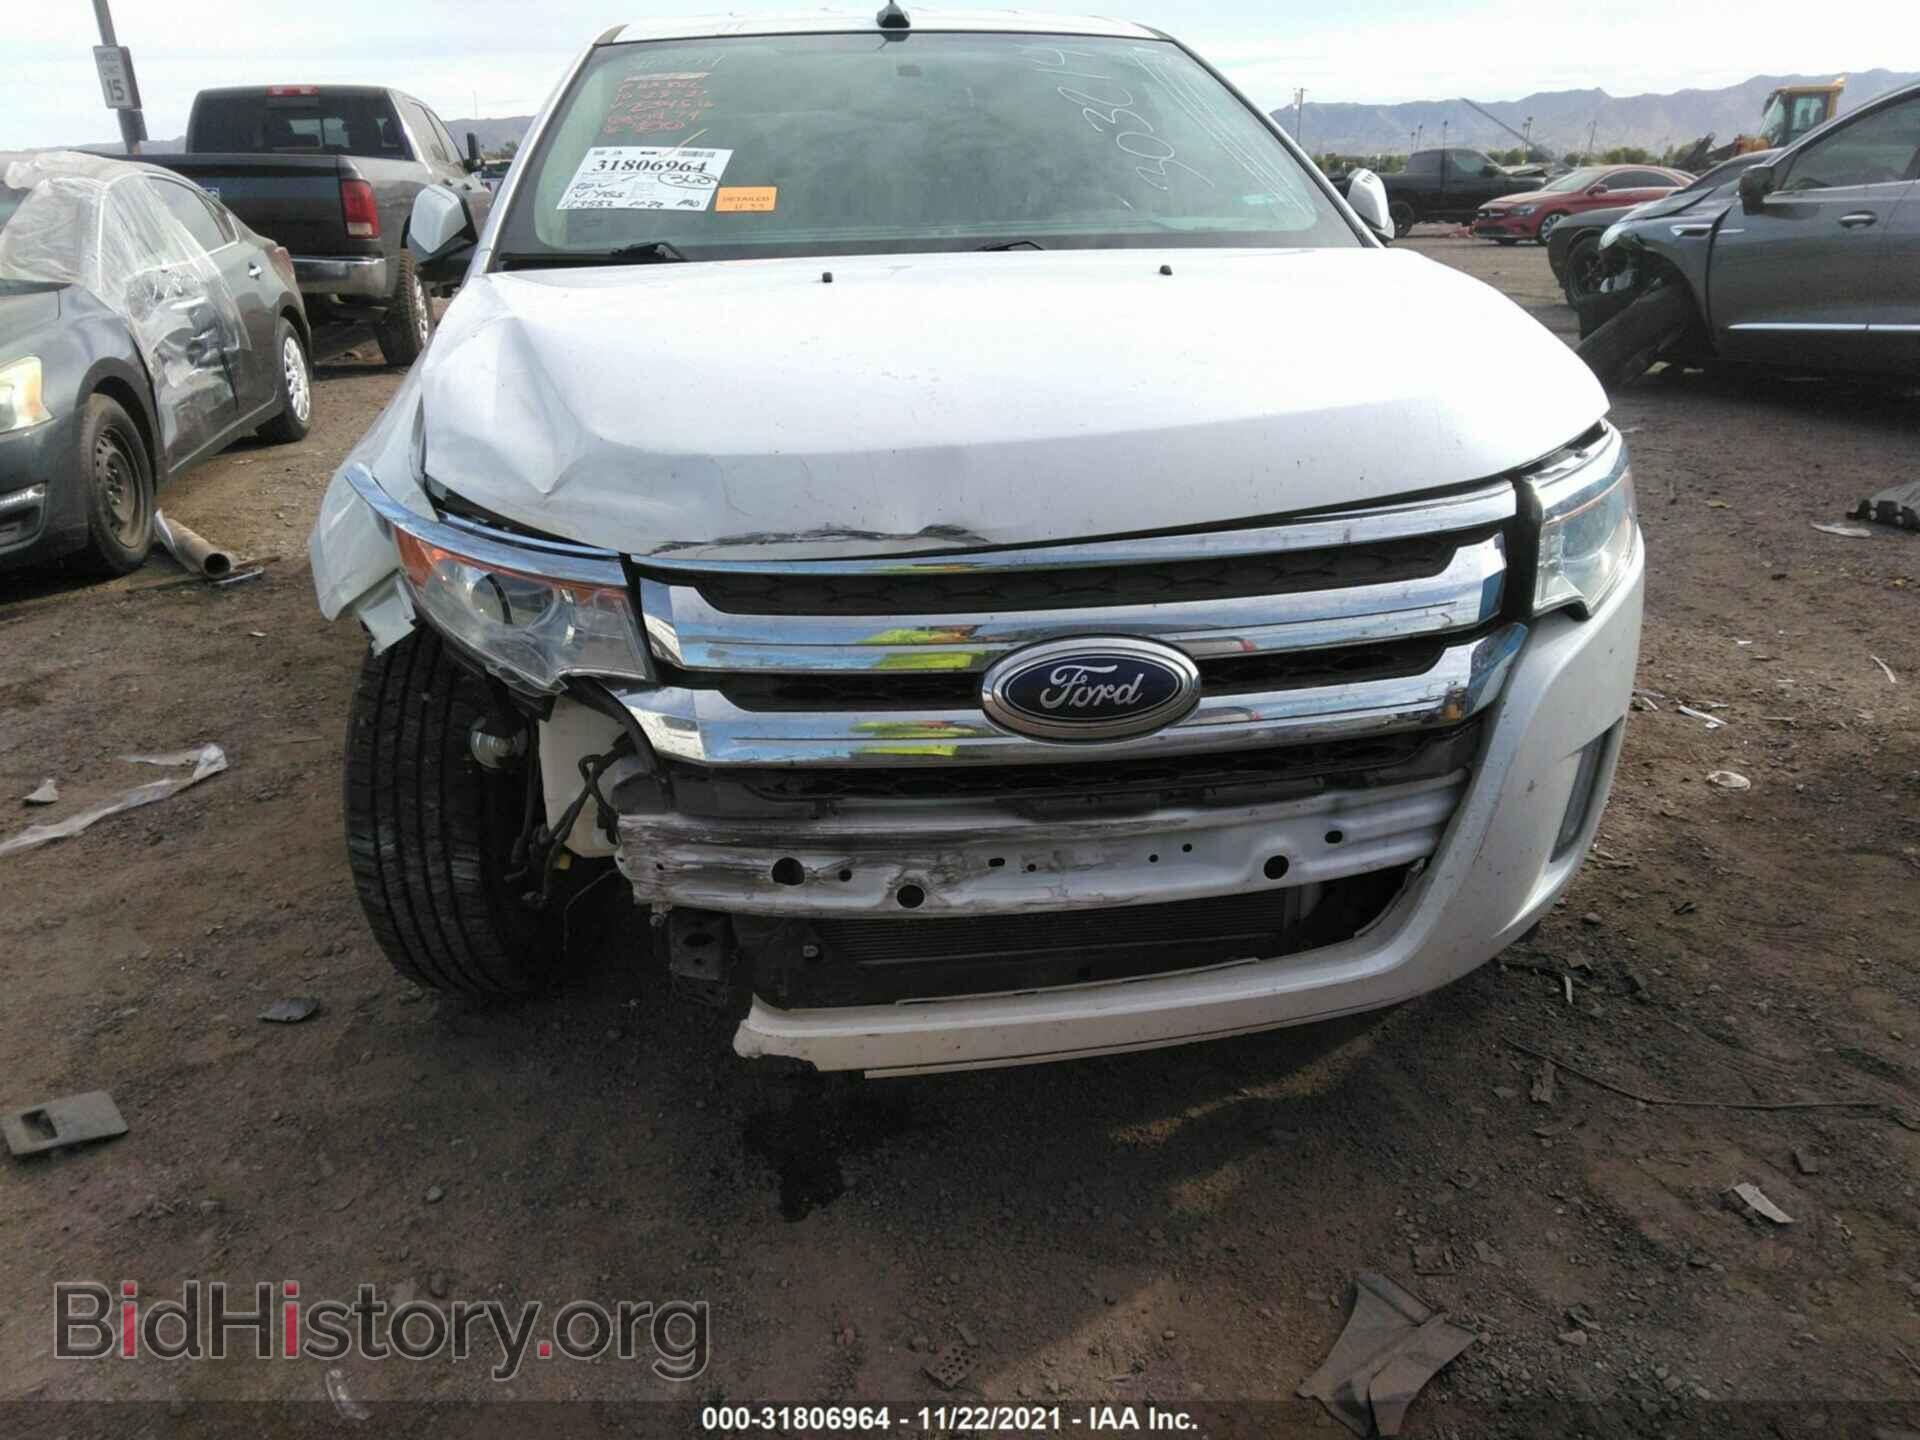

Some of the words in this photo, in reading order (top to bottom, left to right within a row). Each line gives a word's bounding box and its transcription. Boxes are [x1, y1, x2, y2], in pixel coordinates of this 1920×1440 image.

[106, 79, 125, 101] 15
[592, 159, 708, 174] 31806964
[1039, 664, 1145, 709] Ford
